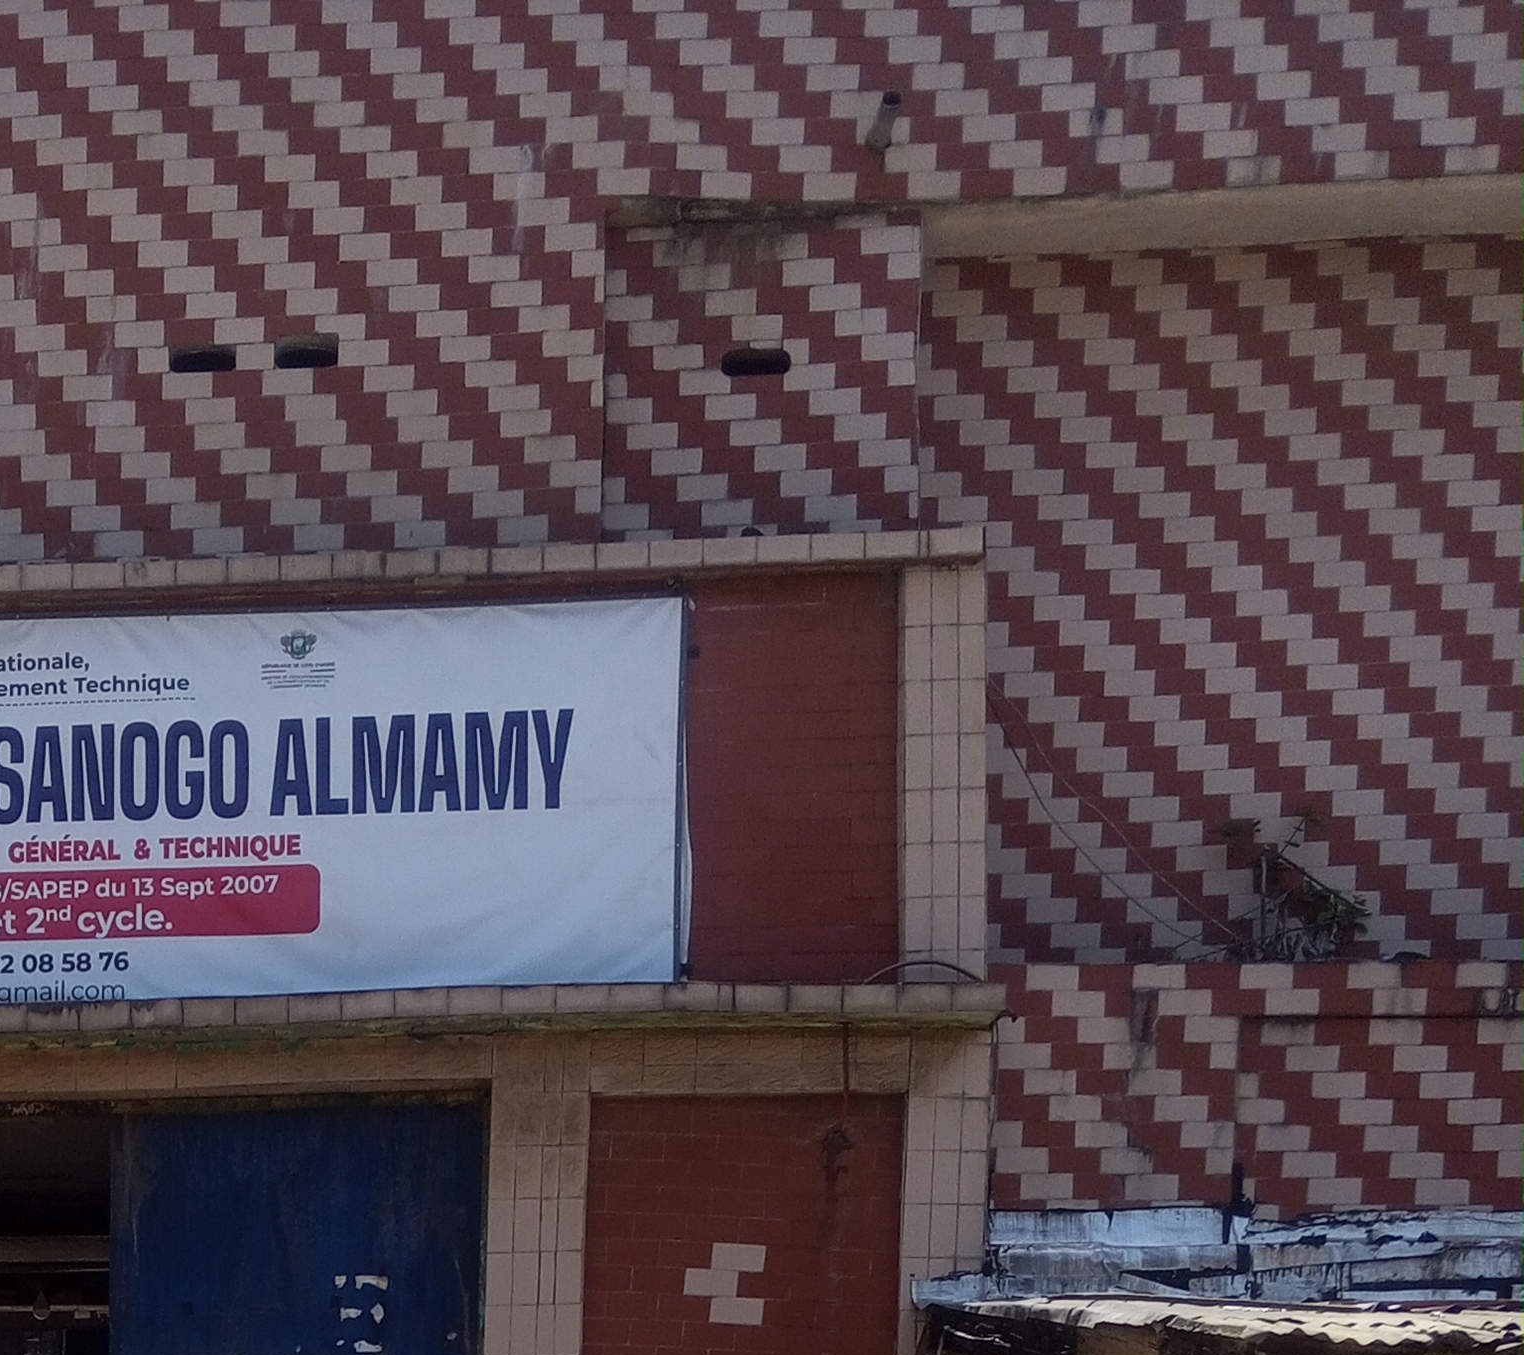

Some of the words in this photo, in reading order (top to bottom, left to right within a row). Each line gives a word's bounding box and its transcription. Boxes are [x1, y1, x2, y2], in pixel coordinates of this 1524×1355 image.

[73, 674, 190, 696] Technique
[270, 708, 574, 816] ALMAMY
[8, 835, 121, 863] GÉNÉRAL
[134, 839, 150, 859] &
[159, 834, 301, 860] TECHNIQUE
[95, 879, 125, 898] du
[132, 877, 153, 896] 13
[161, 877, 213, 900] Sept
[220, 875, 278, 894] 2007
[26, 905, 71, 933] 2nd
[77, 903, 173, 938] cycle.
[22, 954, 54, 973] 08
[61, 953, 92, 973] 58
[99, 952, 129, 971] 76
